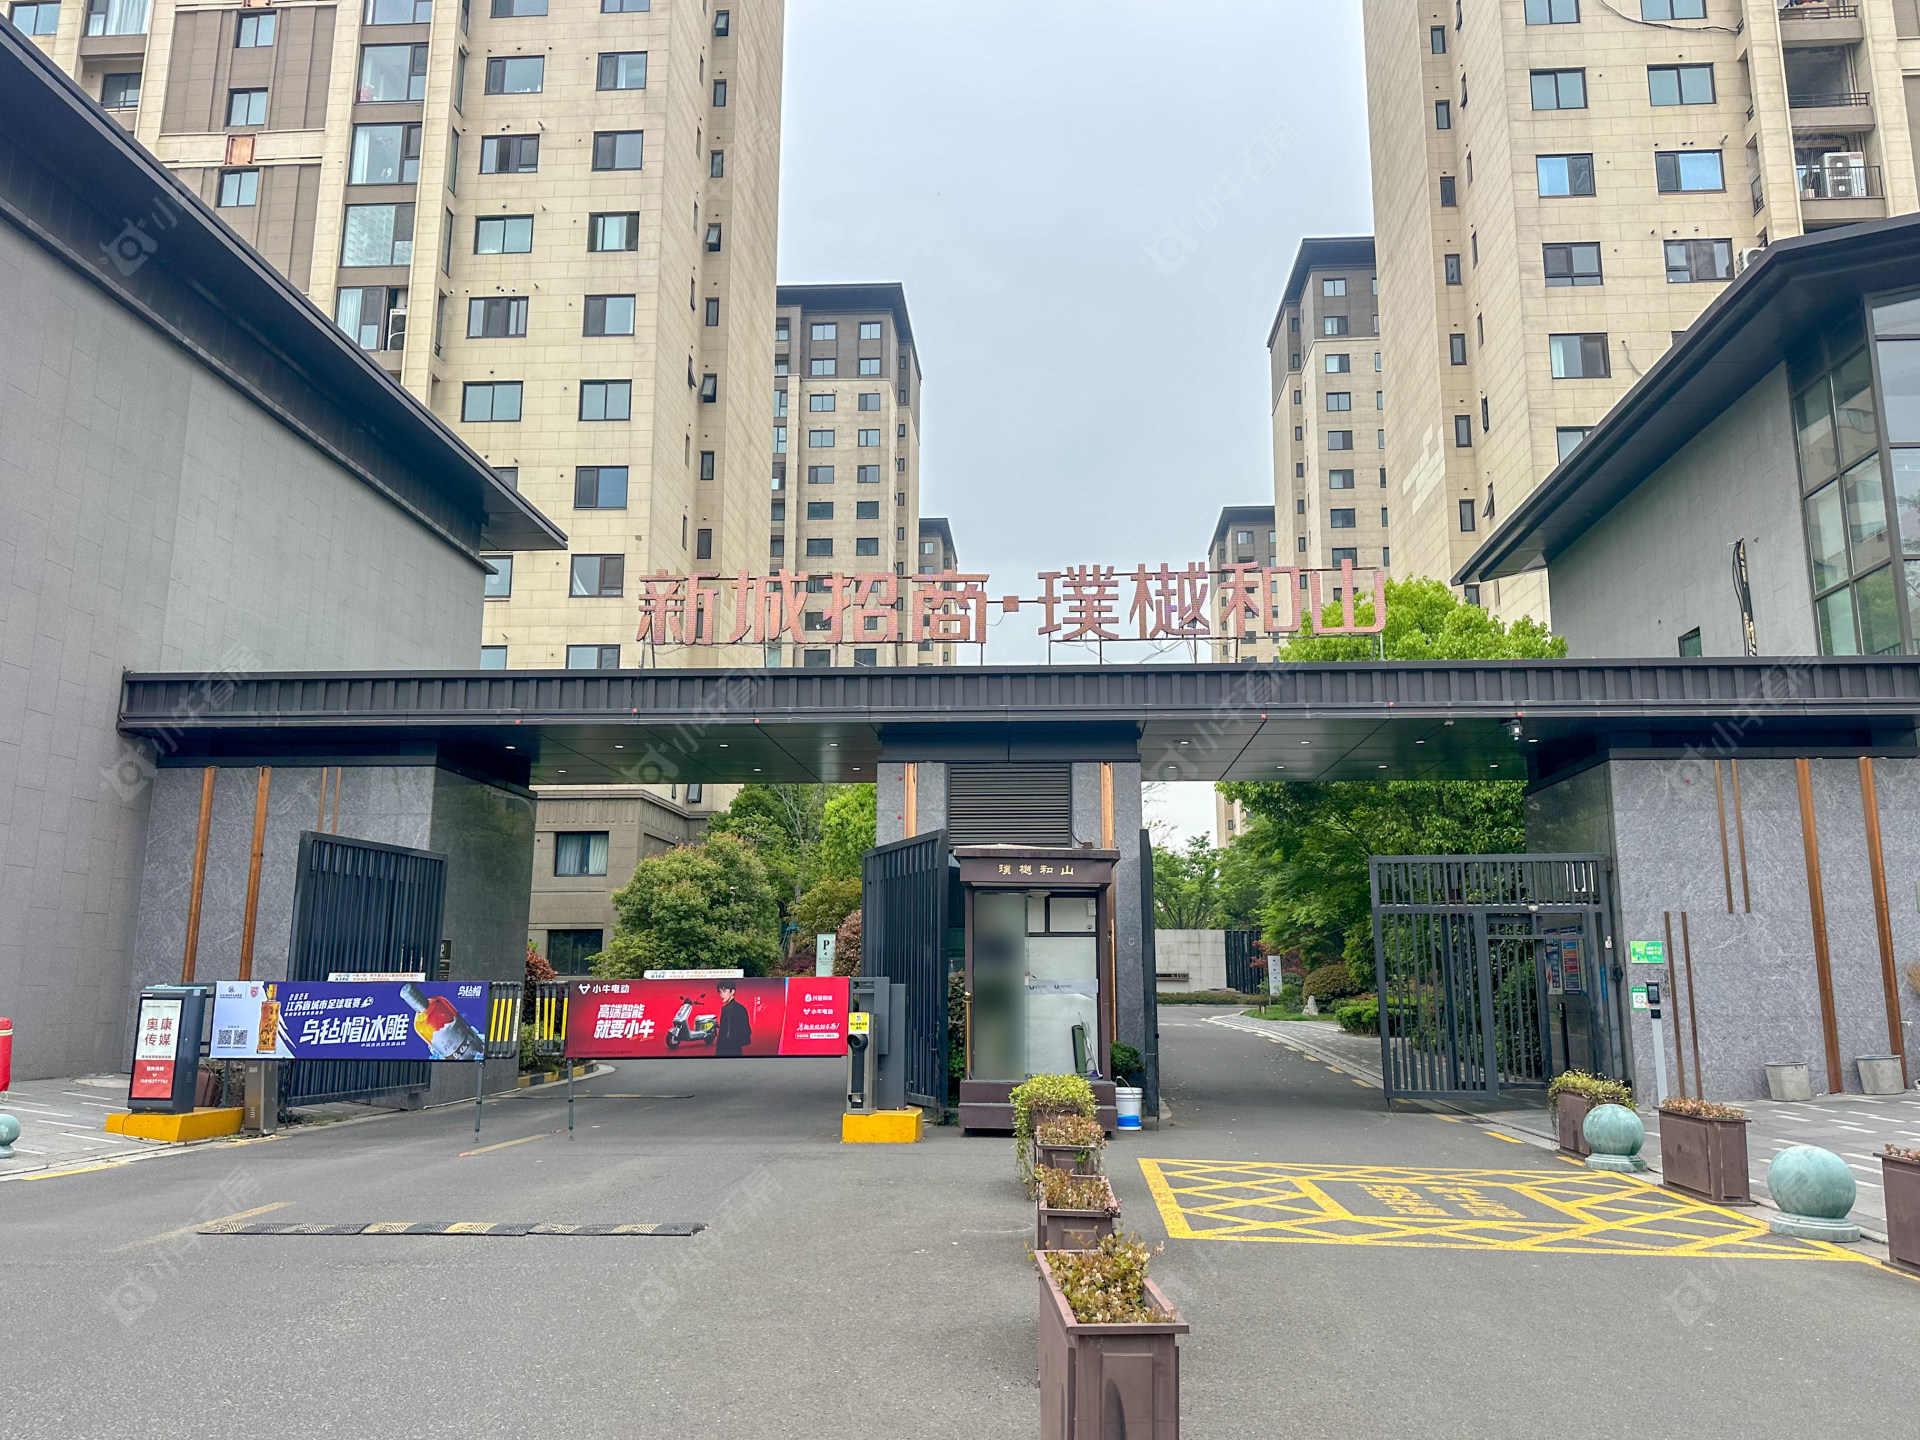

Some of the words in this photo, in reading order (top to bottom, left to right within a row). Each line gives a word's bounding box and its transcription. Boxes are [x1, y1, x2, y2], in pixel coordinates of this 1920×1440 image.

[998, 863, 1074, 876] 璞樾和山
[822, 939, 830, 950] P
[592, 984, 630, 994] 小牛电动
[285, 997, 362, 1012] 江苏省城市足球联赛
[597, 1003, 645, 1019] 高端智能
[146, 1017, 173, 1031] 奥康
[299, 1013, 410, 1045] 乌毡帽冰雕
[593, 1019, 655, 1039] 就要小牛
[144, 1032, 171, 1046] 传媒
